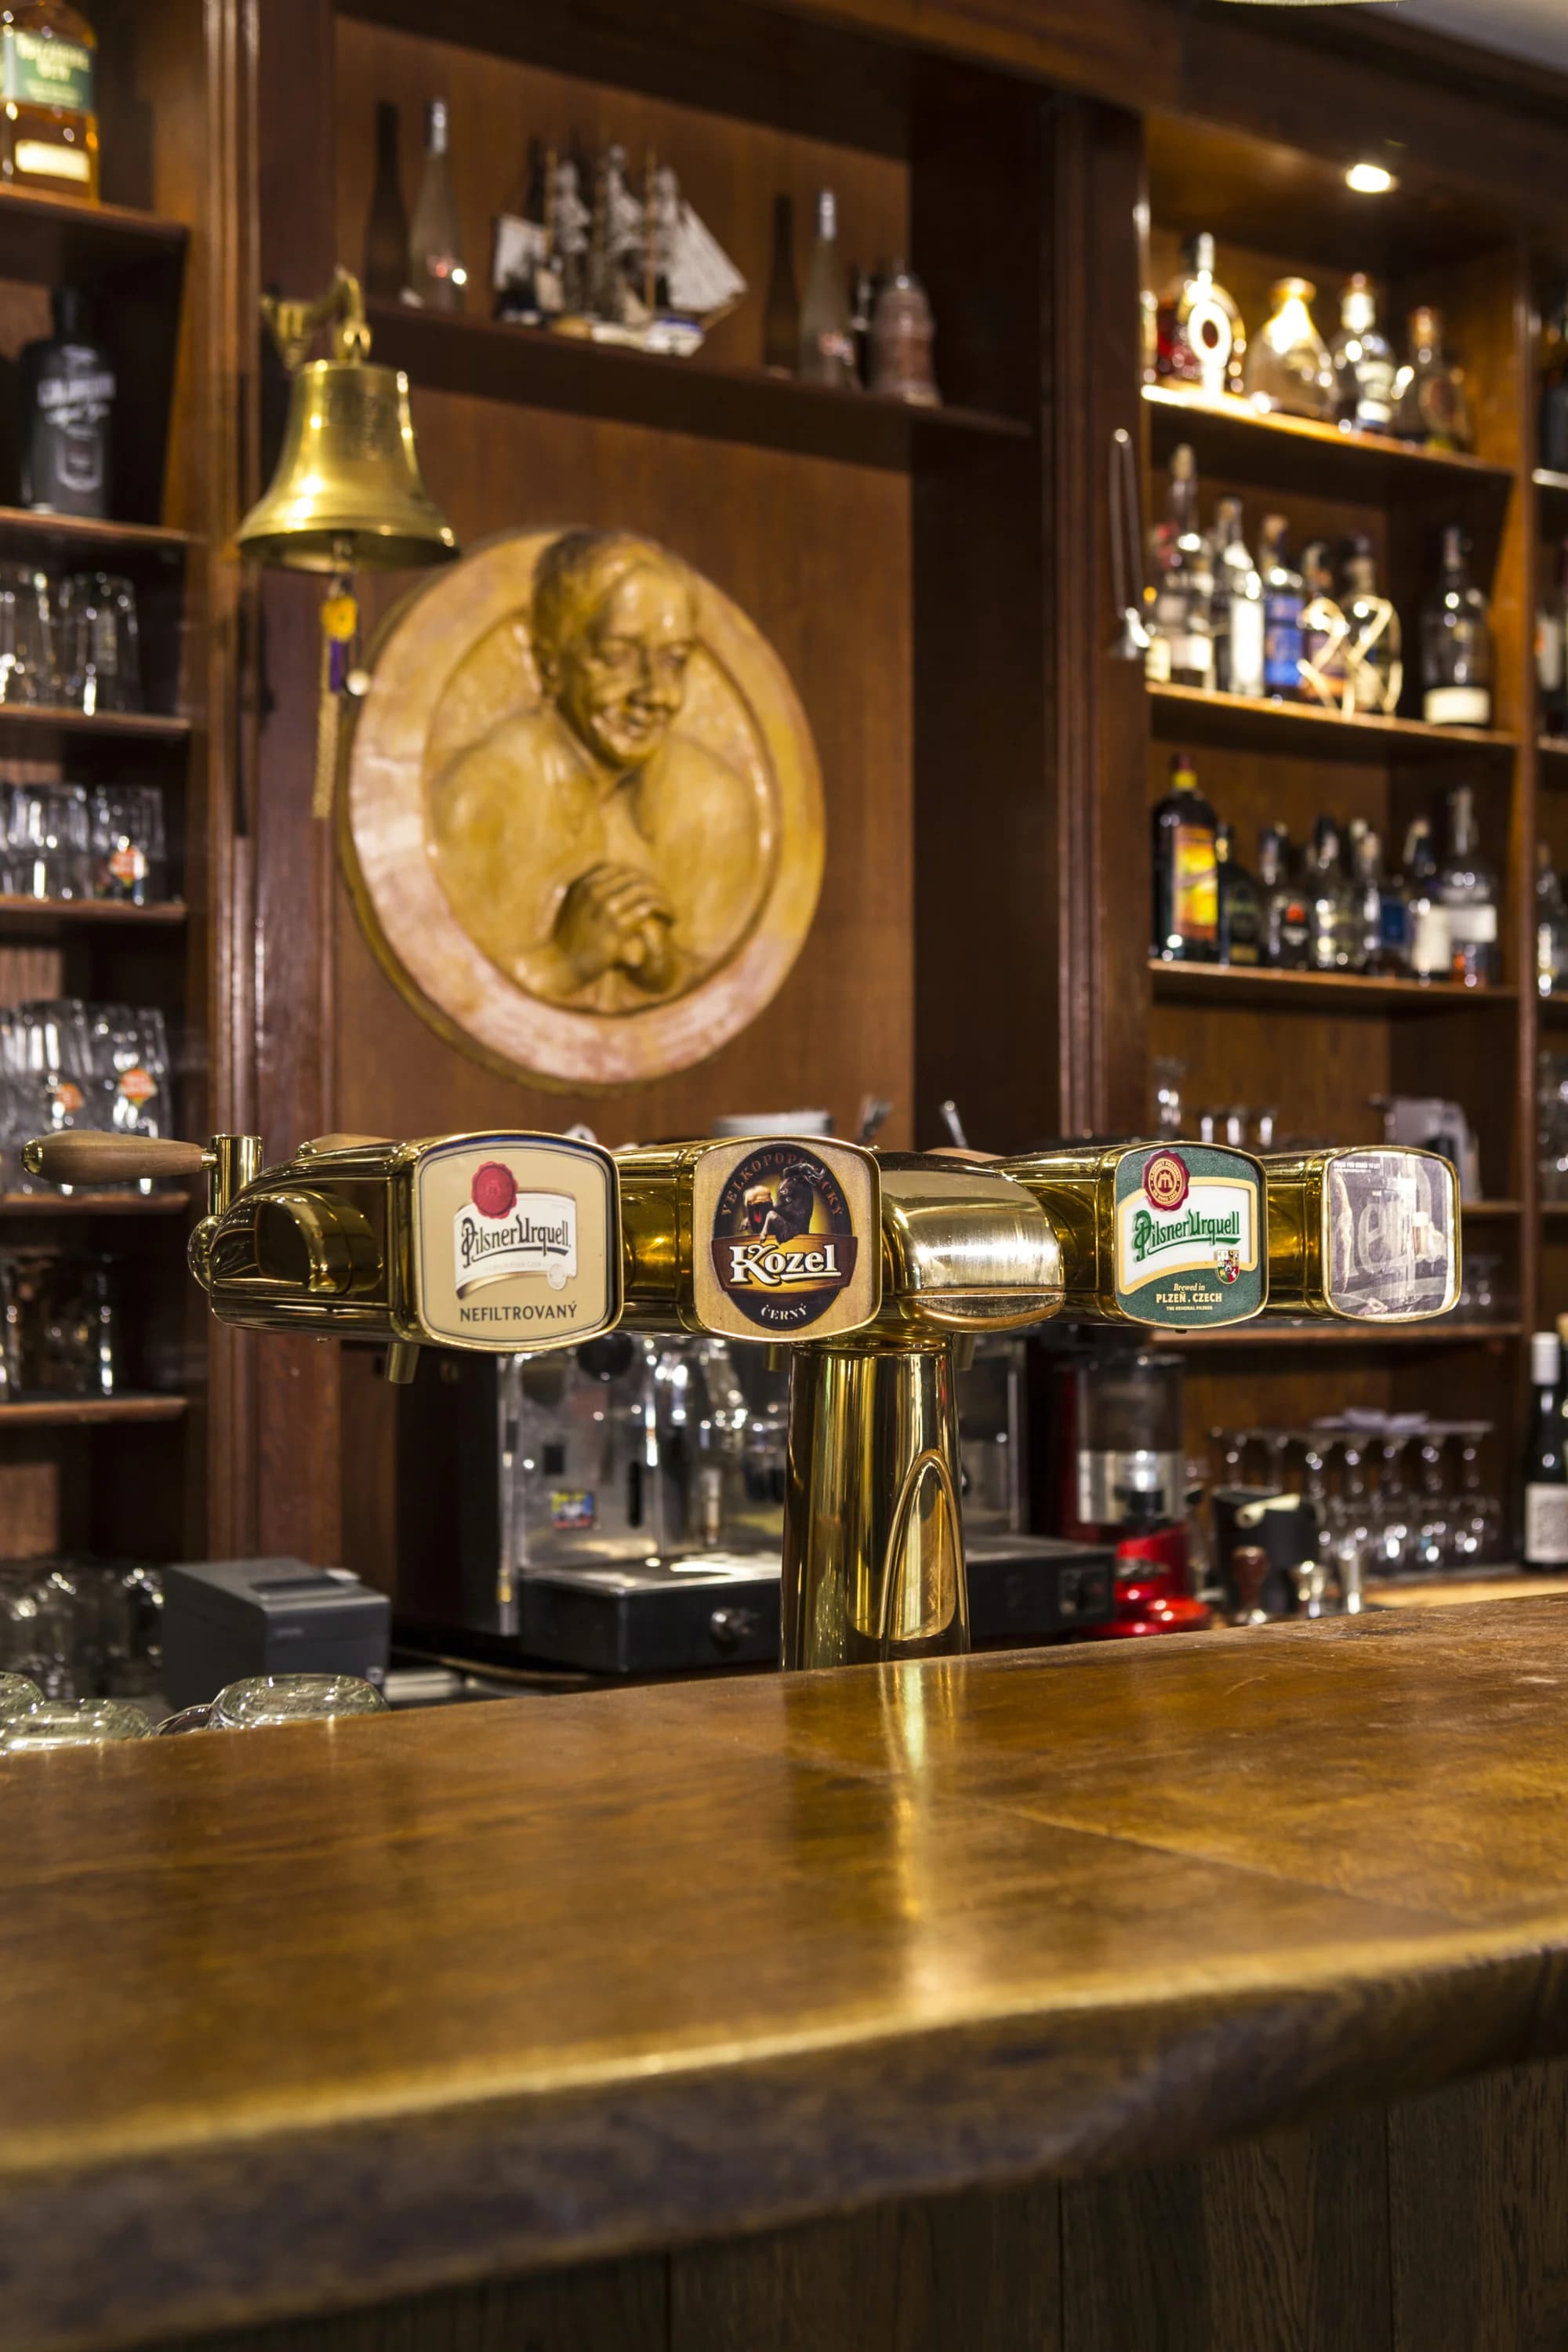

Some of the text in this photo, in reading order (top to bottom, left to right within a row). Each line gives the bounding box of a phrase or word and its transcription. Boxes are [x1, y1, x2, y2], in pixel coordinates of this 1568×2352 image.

[461, 1214, 569, 1268] Pilsner Urquell
[1134, 1208, 1240, 1261] Pilsner Urquell
[729, 1243, 839, 1285] Kozel
[1156, 1291, 1222, 1304] PLZEŇ CZECH
[1173, 1283, 1206, 1292] Brewed in
[459, 1301, 578, 1323] NEFILTROVANÝ
[760, 1303, 807, 1320] ČERNÝ
